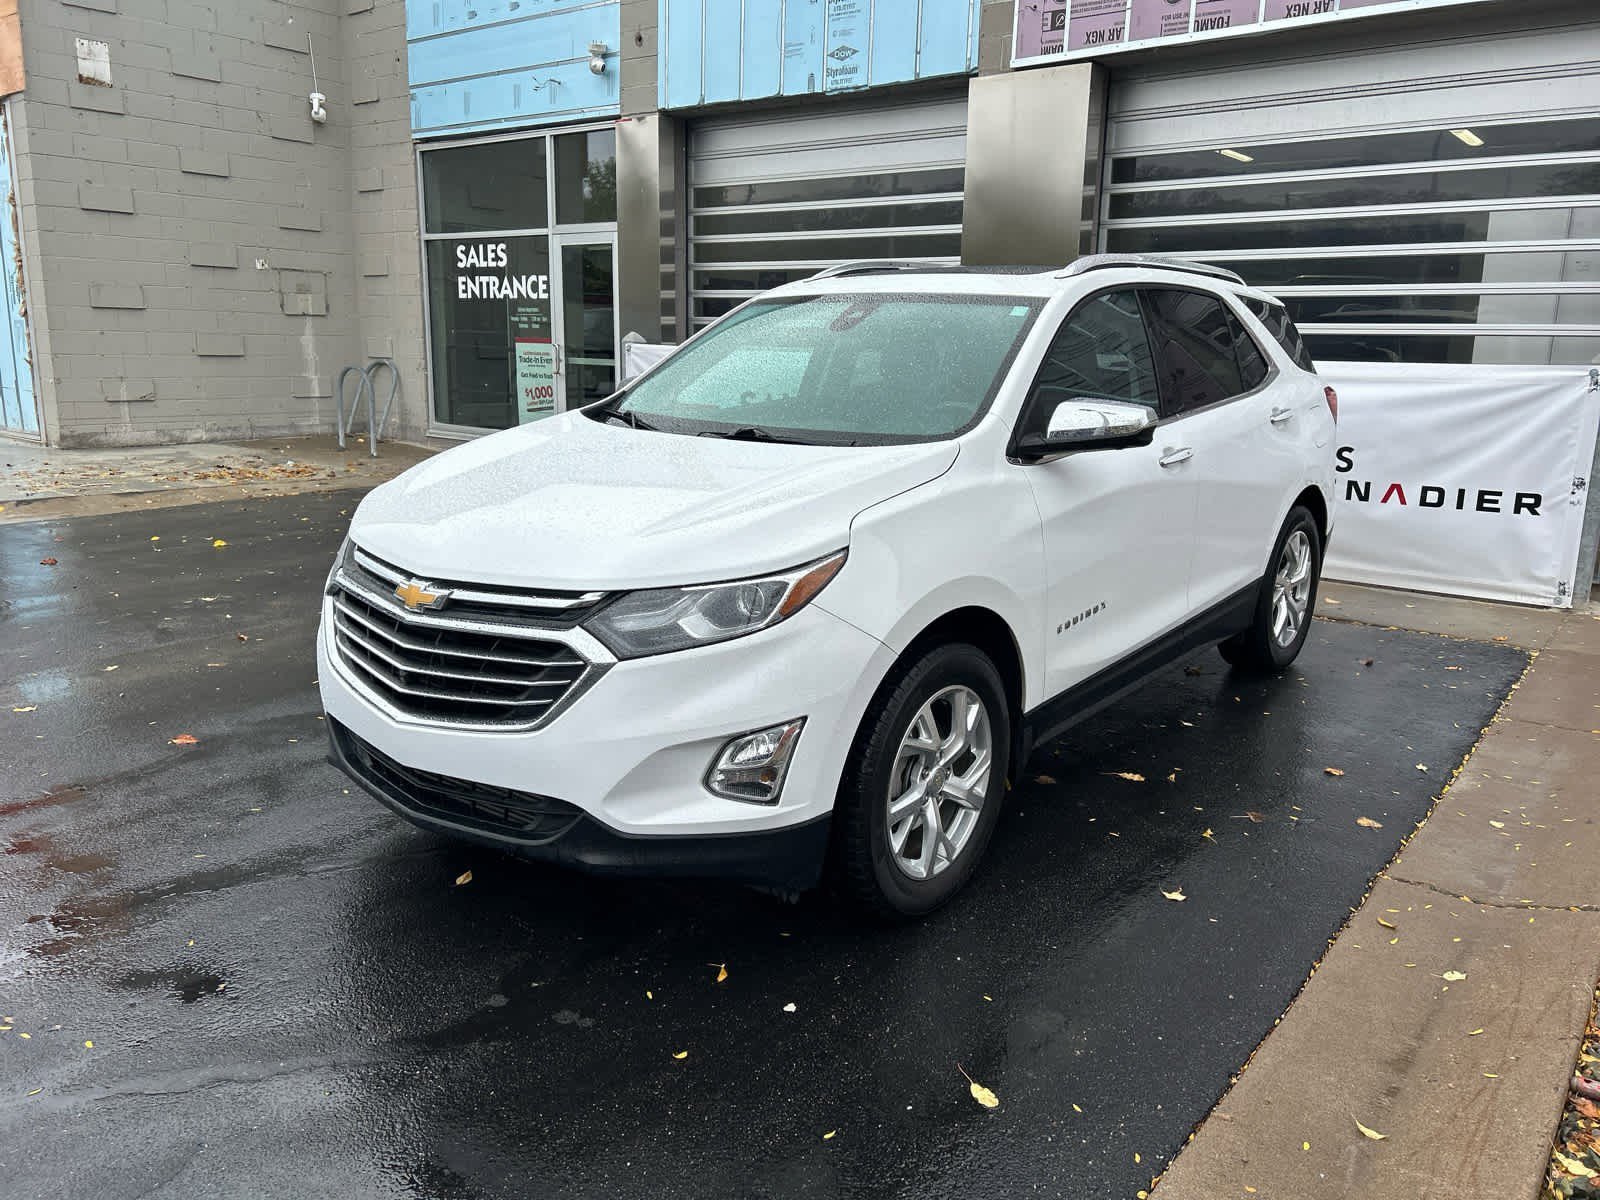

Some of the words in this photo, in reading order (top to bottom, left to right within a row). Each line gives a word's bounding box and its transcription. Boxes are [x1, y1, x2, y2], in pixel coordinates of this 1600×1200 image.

[1085, 29, 1105, 44] NGX
[826, 65, 858, 79] Styrofoam
[456, 243, 508, 269] SALES
[457, 275, 549, 299] ENTRANCE
[524, 385, 554, 401] $1,000
[1344, 479, 1543, 516] NADIER
[1056, 601, 1106, 635] EQUINOX
